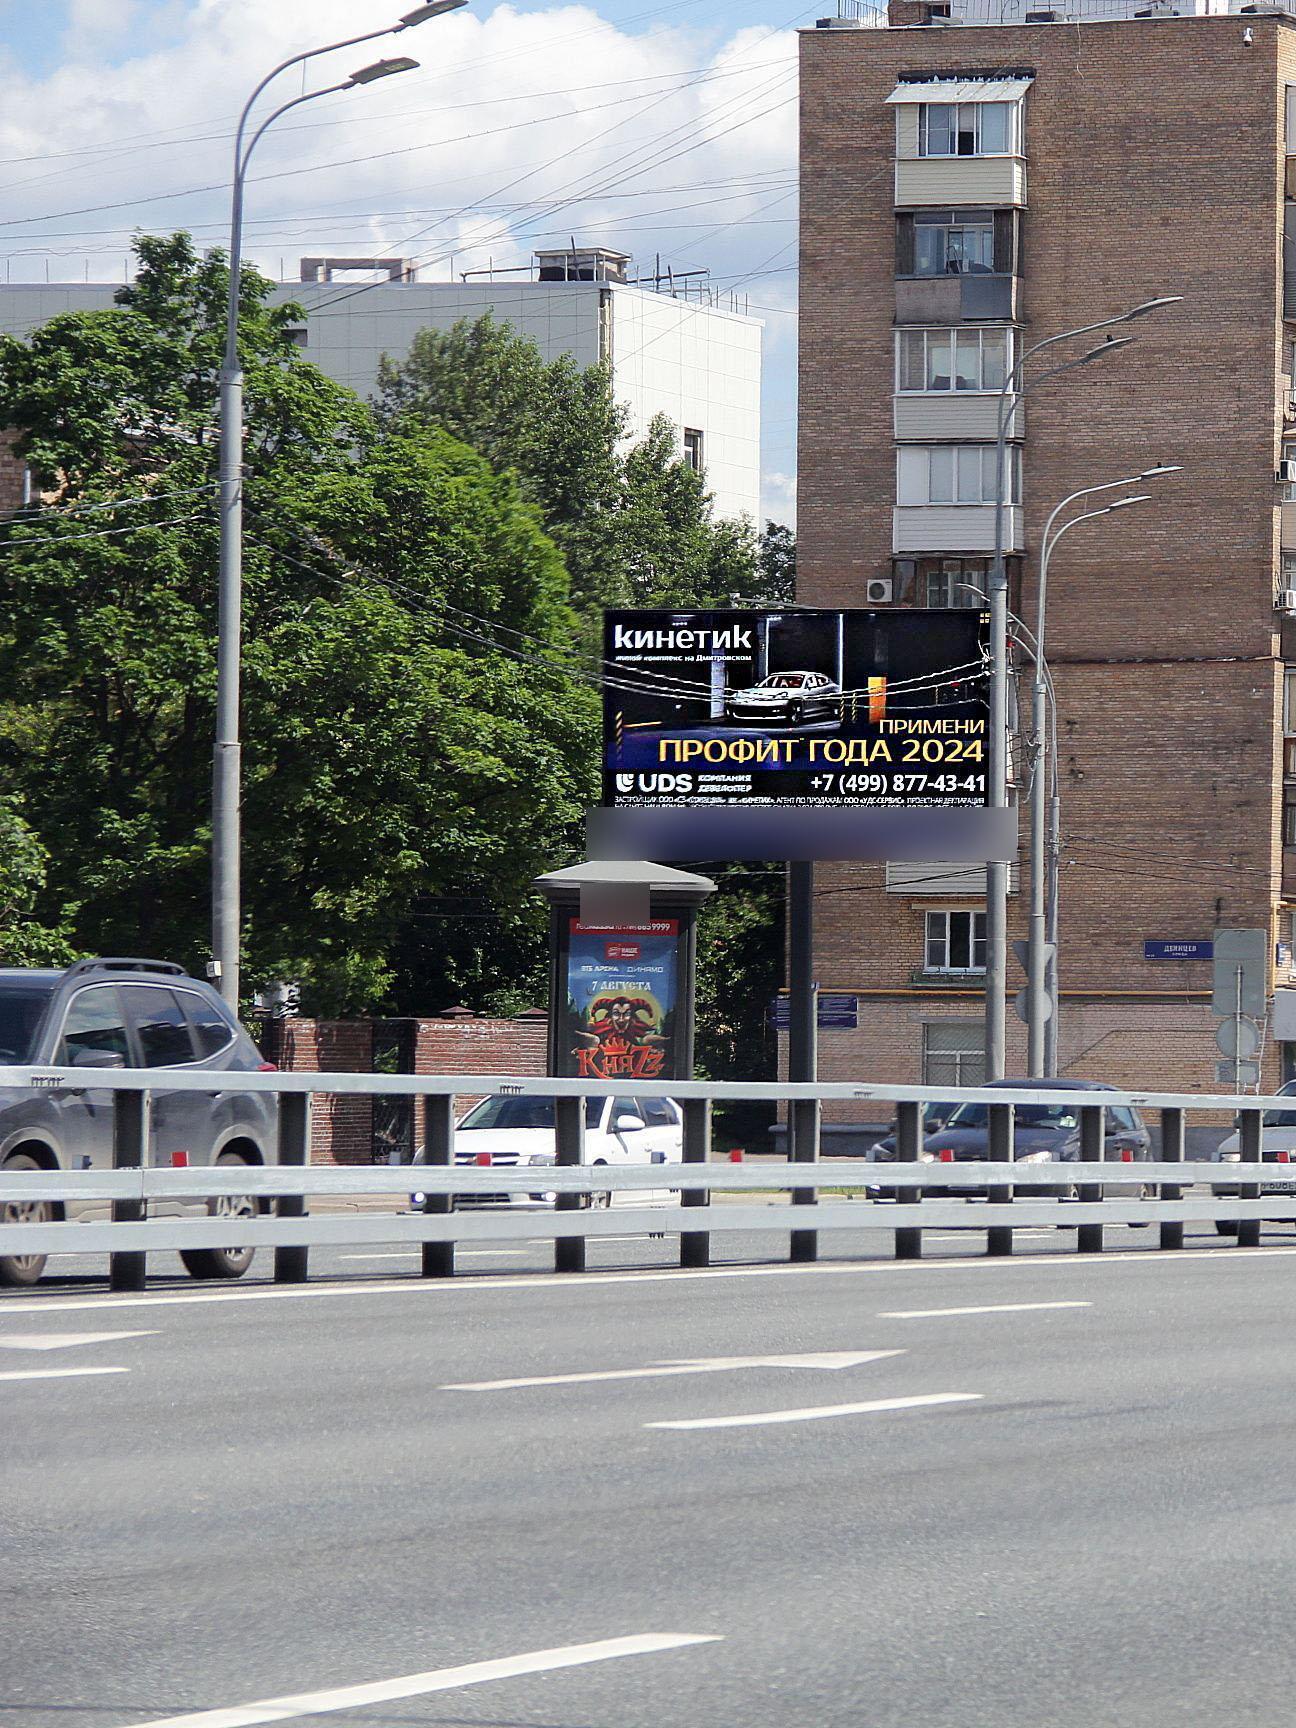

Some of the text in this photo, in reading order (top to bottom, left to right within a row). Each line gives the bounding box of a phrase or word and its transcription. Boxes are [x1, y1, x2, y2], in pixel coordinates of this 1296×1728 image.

[696, 654, 752, 662] Дмитровском
[879, 719, 985, 734] ПРИМЕНИ
[659, 738, 985, 766] ПРОФИТ ГОДА 2024
[811, 774, 985, 794] +7 (499) 877-43-41
[591, 981, 652, 991] 7 АВГУСТА
